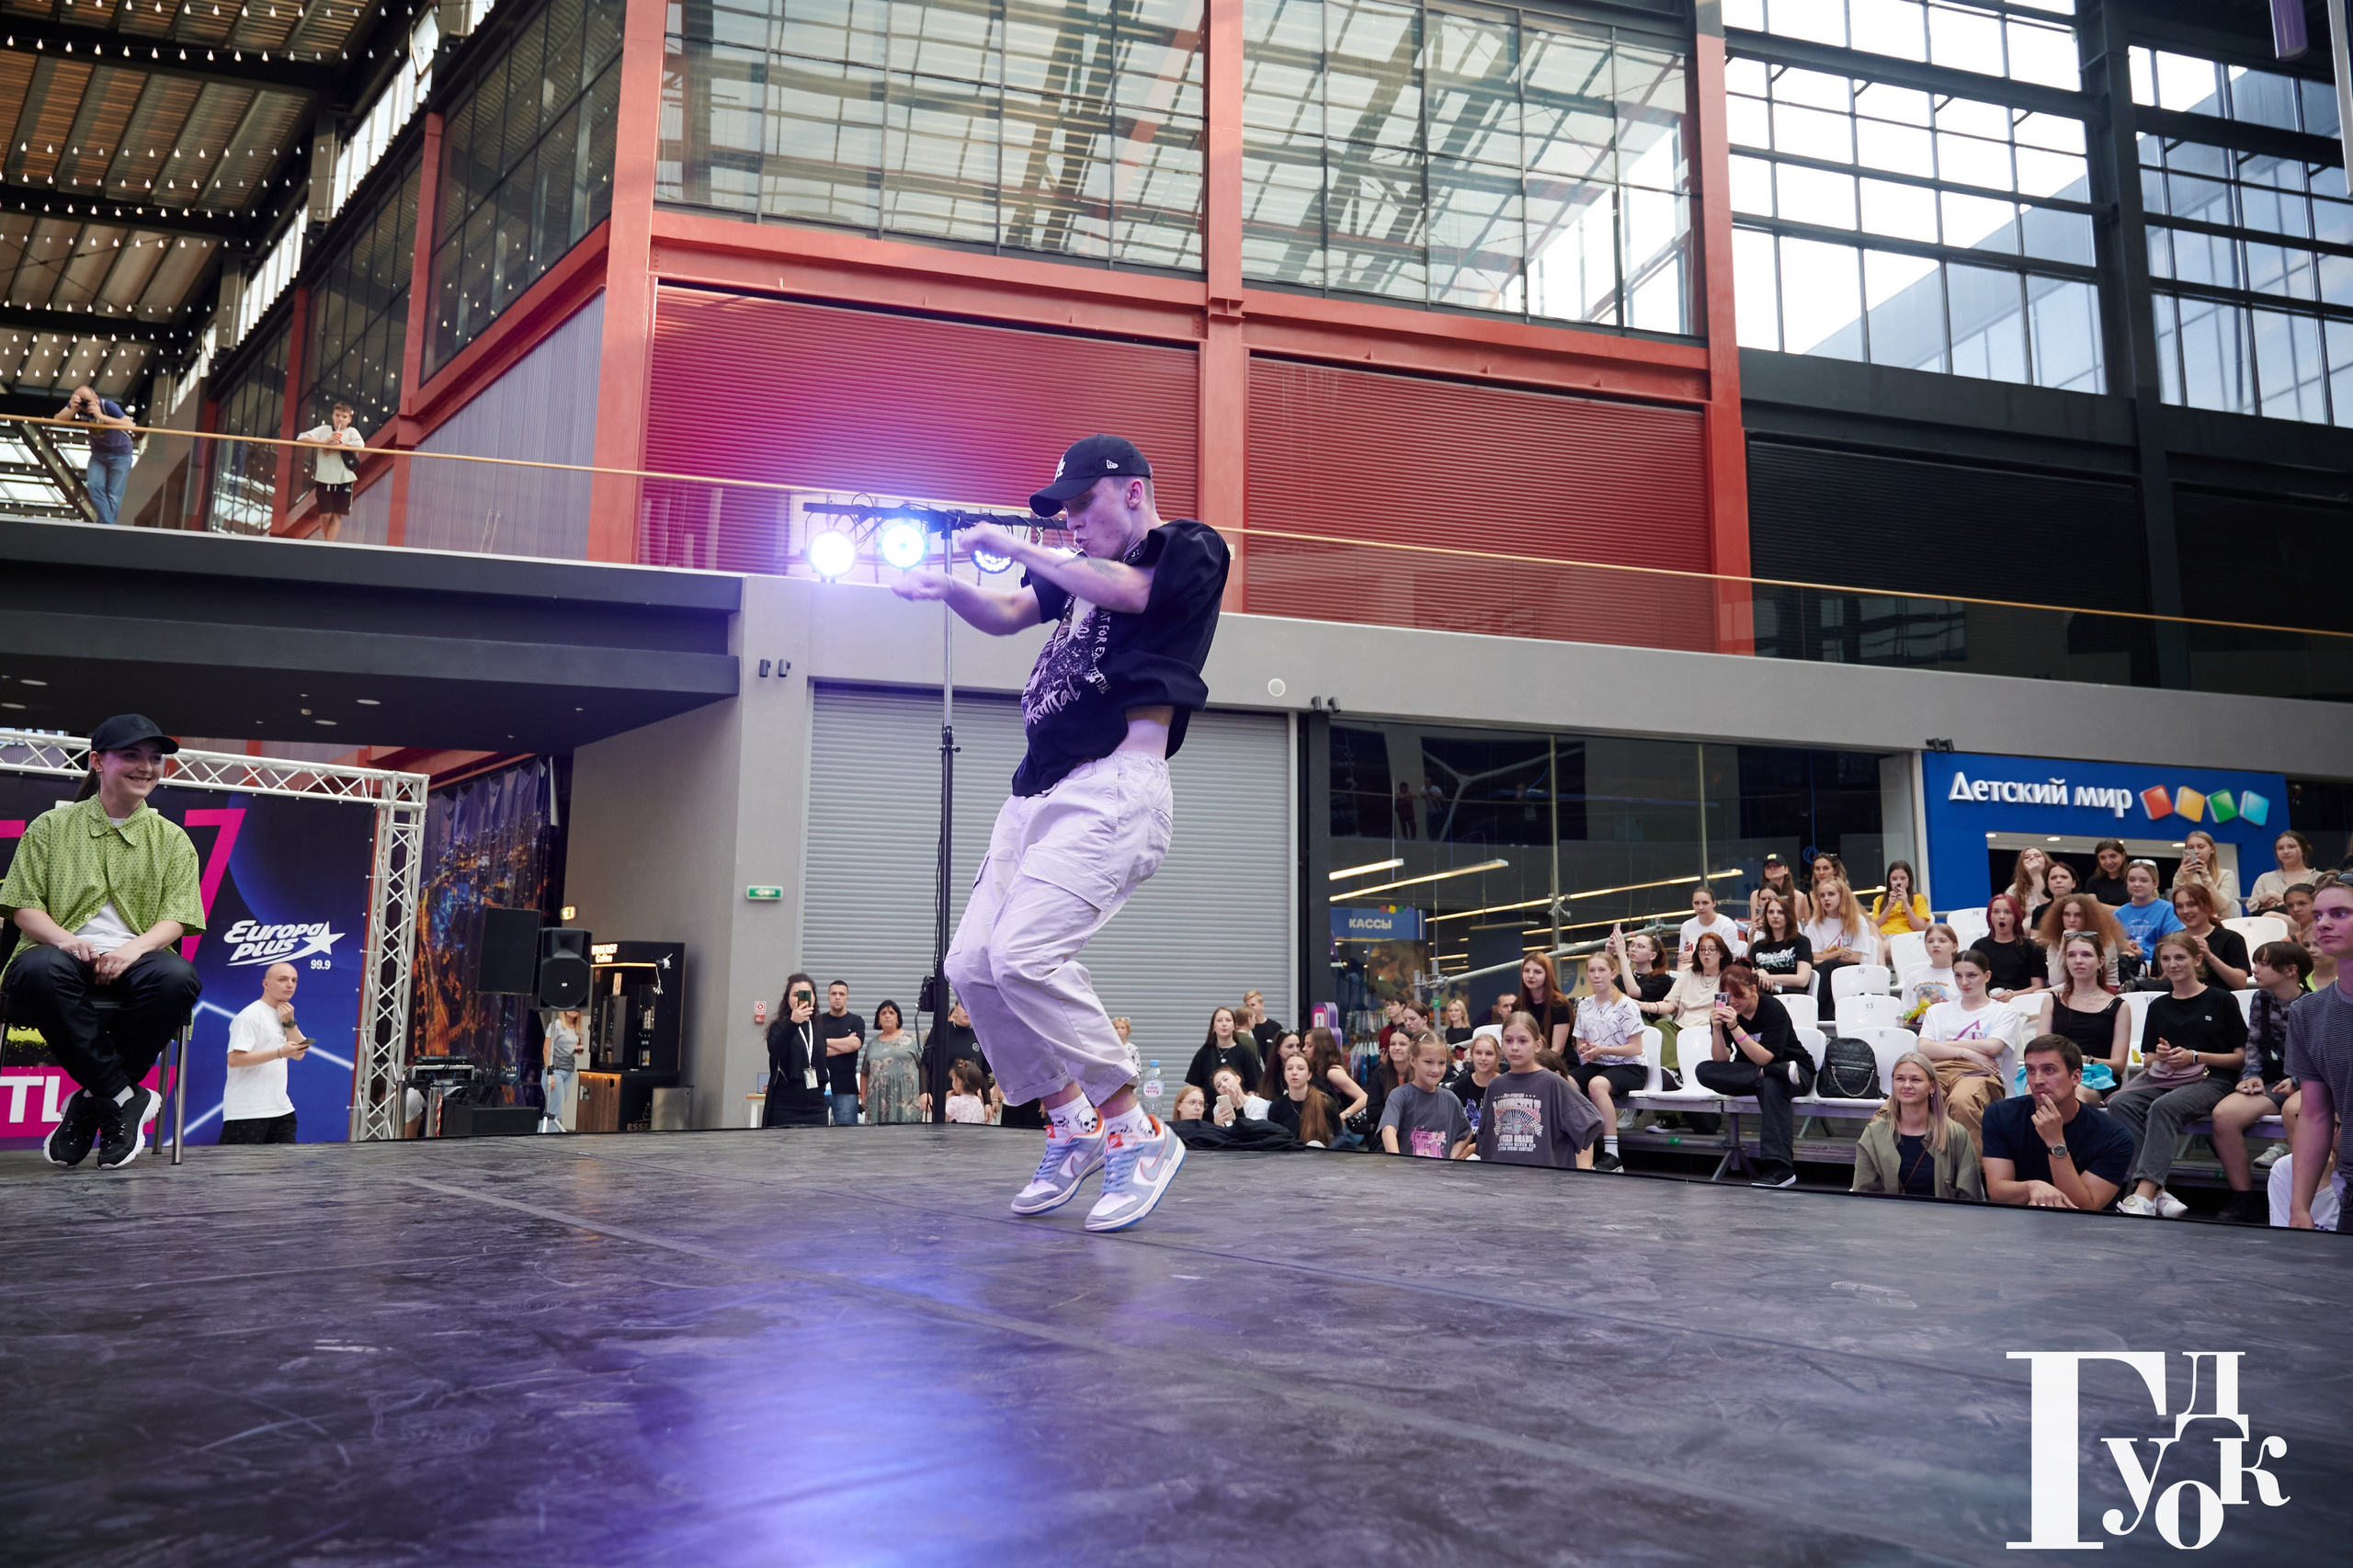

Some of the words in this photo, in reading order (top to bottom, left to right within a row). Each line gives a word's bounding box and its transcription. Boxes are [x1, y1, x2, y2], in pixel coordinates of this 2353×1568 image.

[1096, 626, 1109, 643] FOR
[1949, 772, 2069, 805] Детский
[2074, 786, 2132, 818] мир
[1348, 918, 1392, 929] КАССЫ
[310, 960, 331, 970] 99.9
